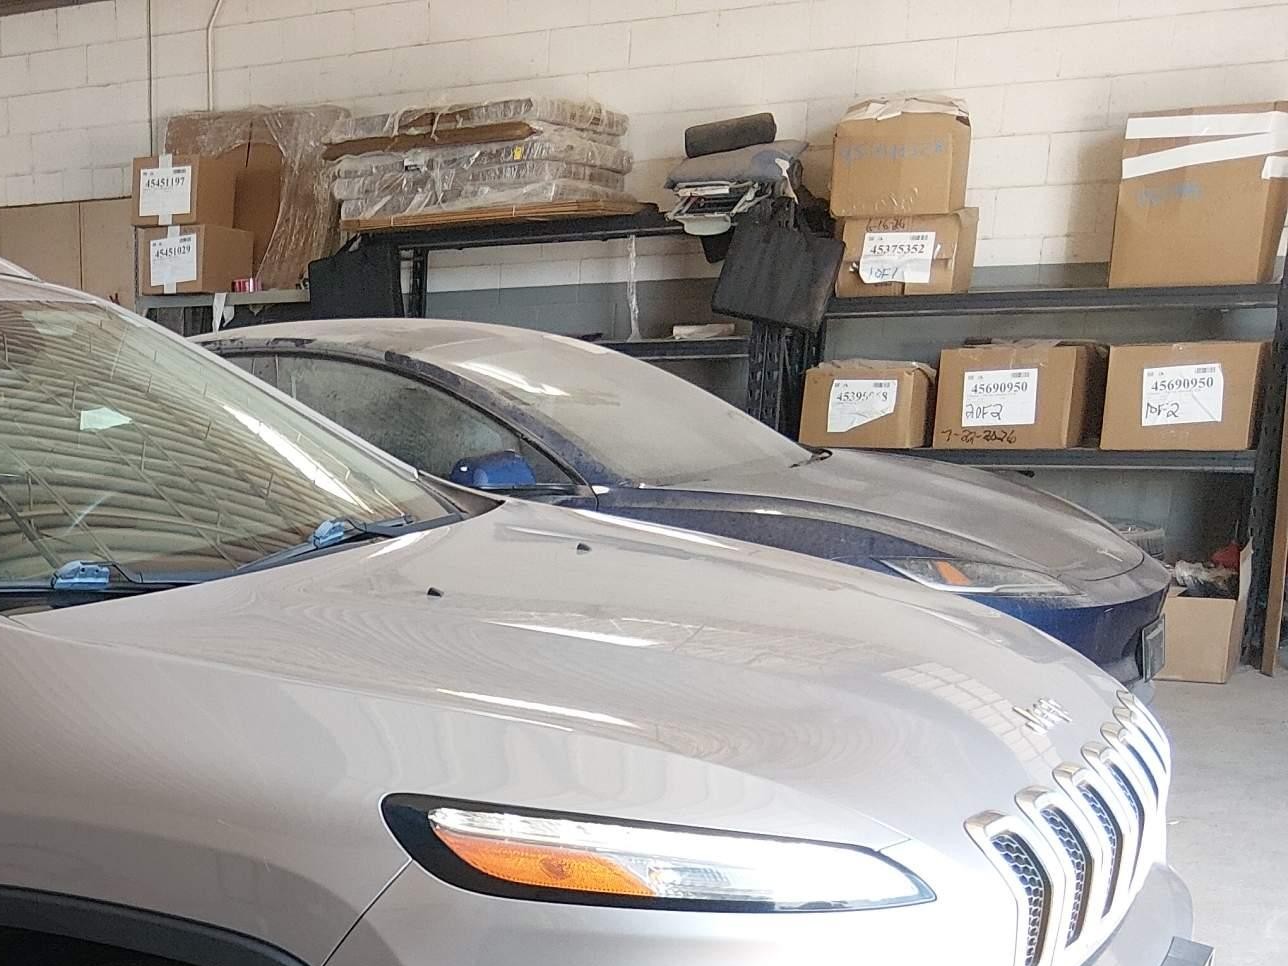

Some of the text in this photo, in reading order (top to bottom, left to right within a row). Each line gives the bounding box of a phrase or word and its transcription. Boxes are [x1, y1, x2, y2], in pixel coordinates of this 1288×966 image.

[870, 244, 925, 255] 45375352
[971, 382, 1028, 394] 45690950
[1151, 377, 1214, 391] 45690950
